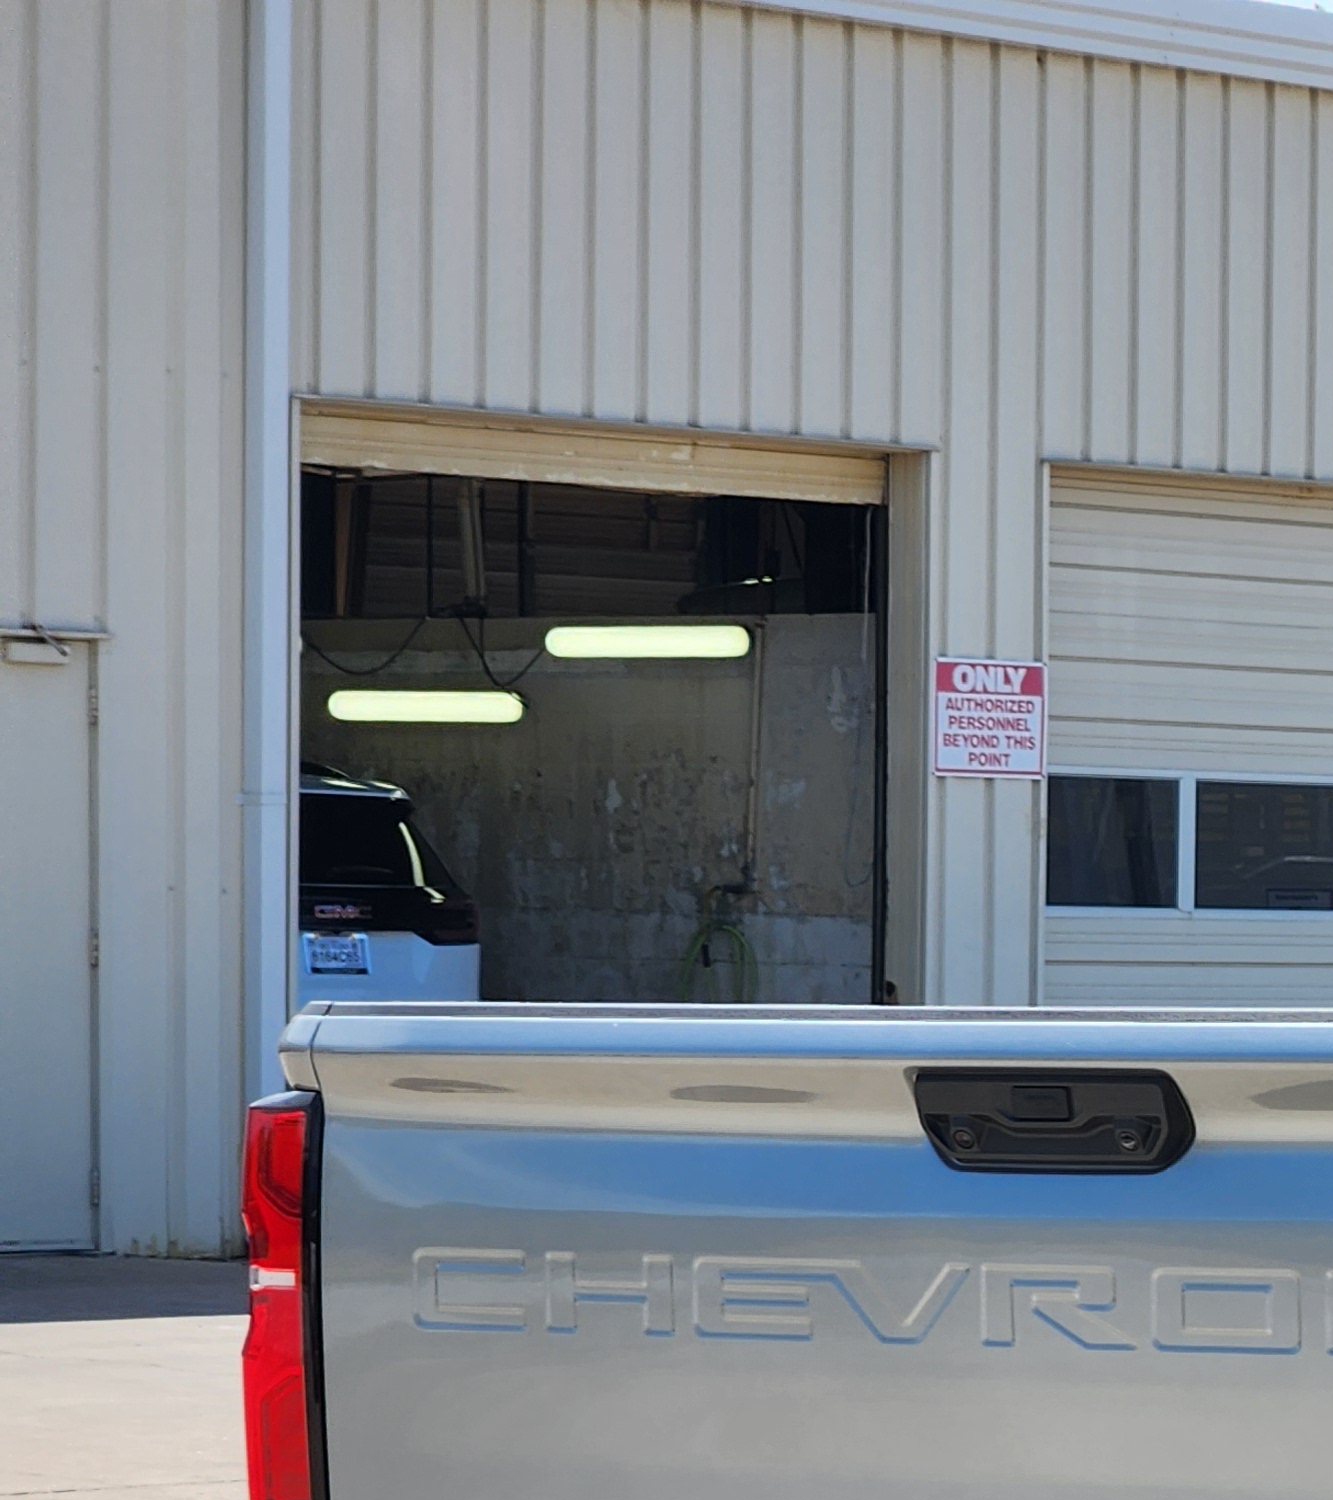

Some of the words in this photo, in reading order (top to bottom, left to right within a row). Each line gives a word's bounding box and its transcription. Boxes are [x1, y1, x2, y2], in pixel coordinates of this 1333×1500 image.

[952, 664, 1028, 694] ONLY
[945, 697, 1035, 714] AUTHORIZED
[948, 716, 1031, 732] PERSONNEL
[943, 733, 1000, 749] BEYOND
[1005, 735, 1036, 751] THIS
[968, 752, 1011, 768] POINT
[314, 904, 373, 919] GMC
